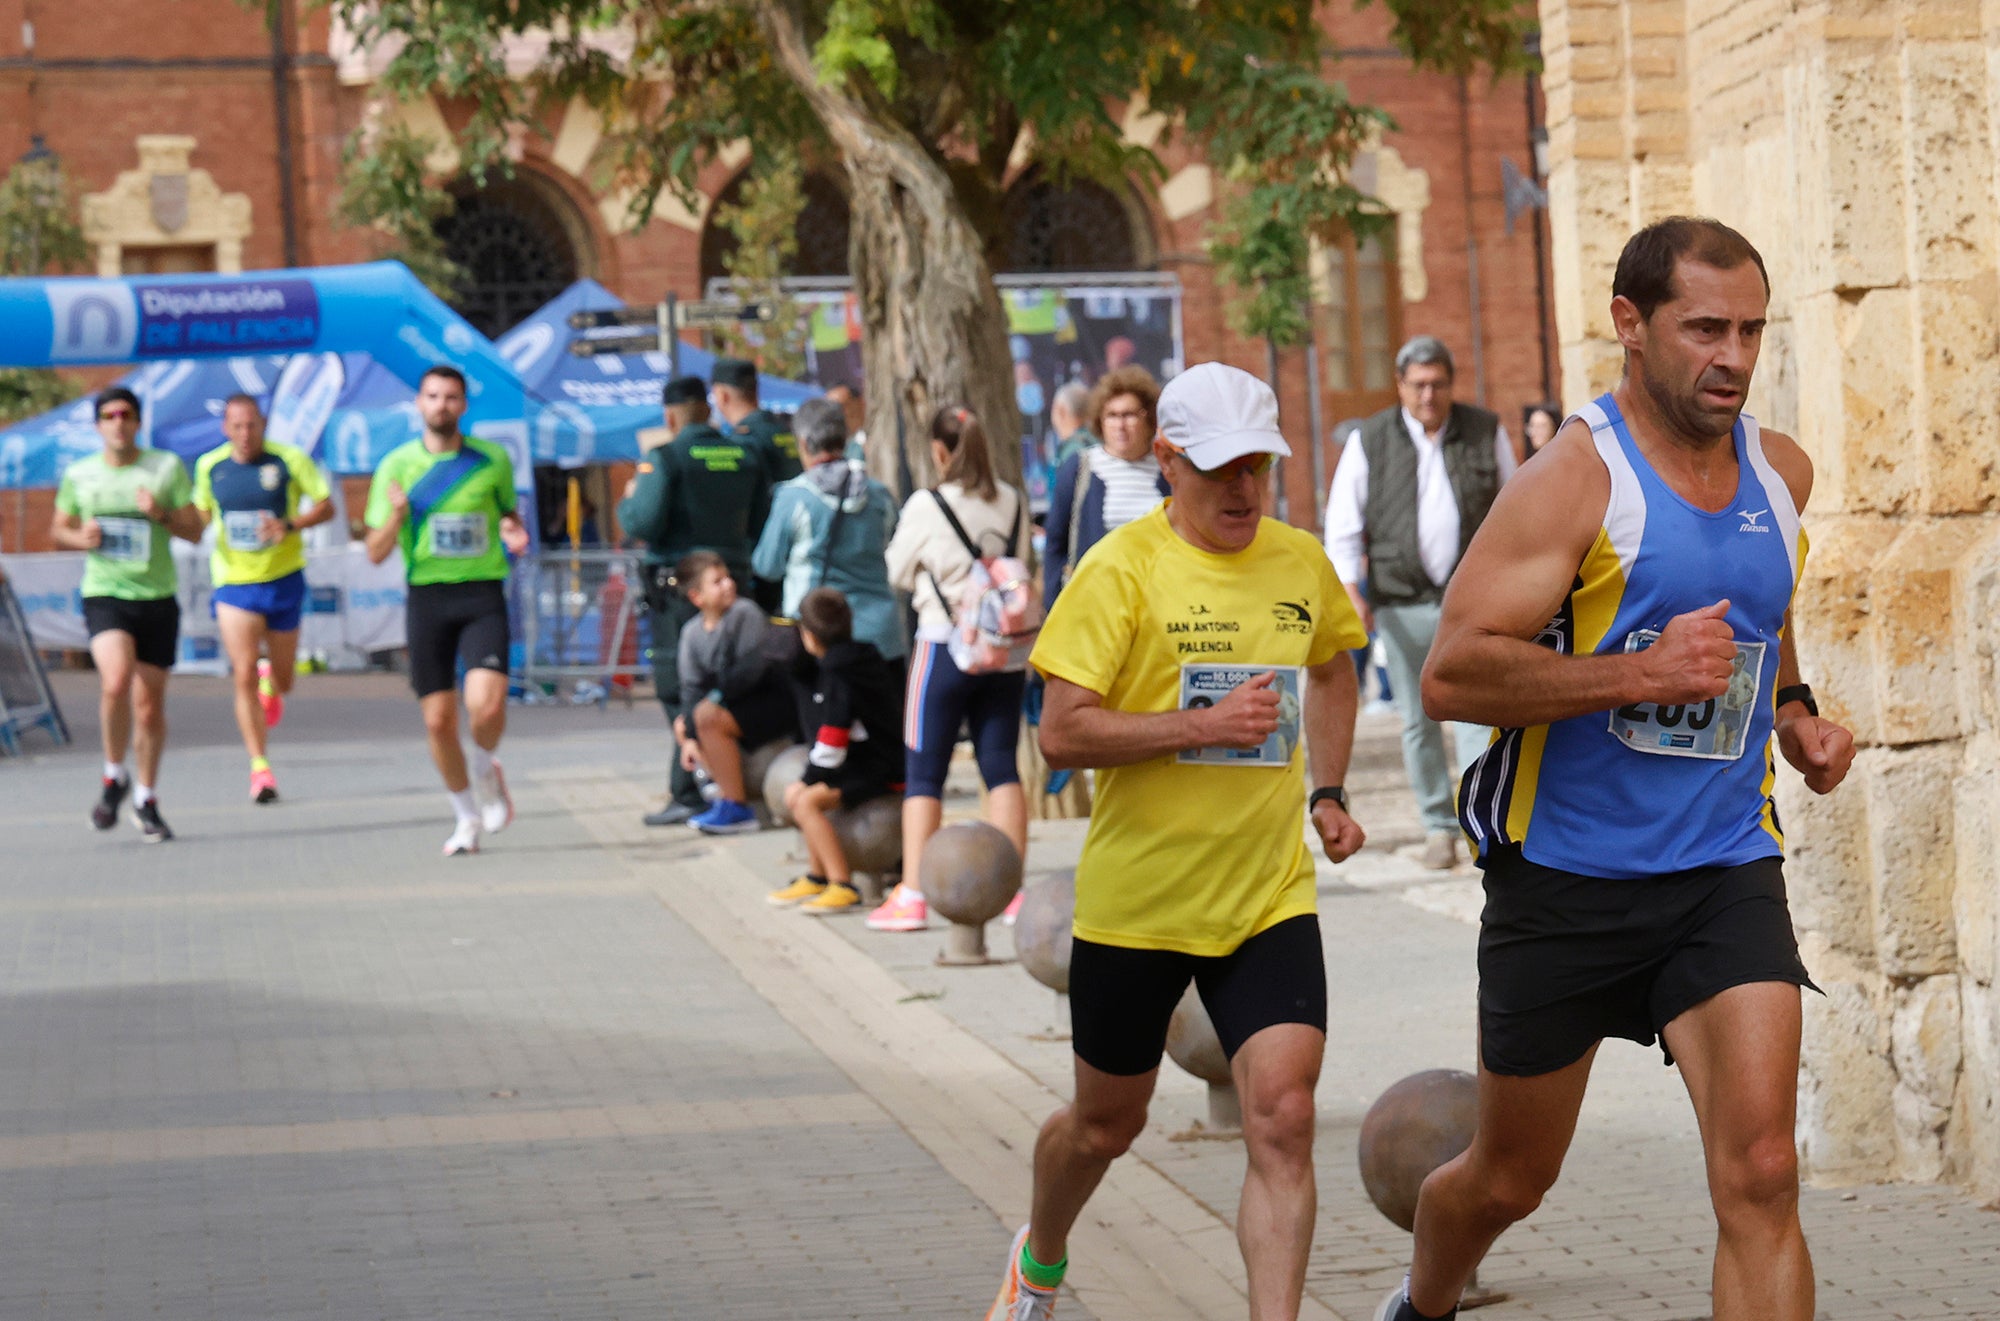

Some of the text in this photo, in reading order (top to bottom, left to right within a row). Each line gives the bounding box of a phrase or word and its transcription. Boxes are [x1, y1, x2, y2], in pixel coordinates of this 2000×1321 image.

[142, 287, 286, 318] Diputación
[1166, 621, 1240, 633] SAN ANTONIO
[1178, 641, 1233, 653] PALENCIA
